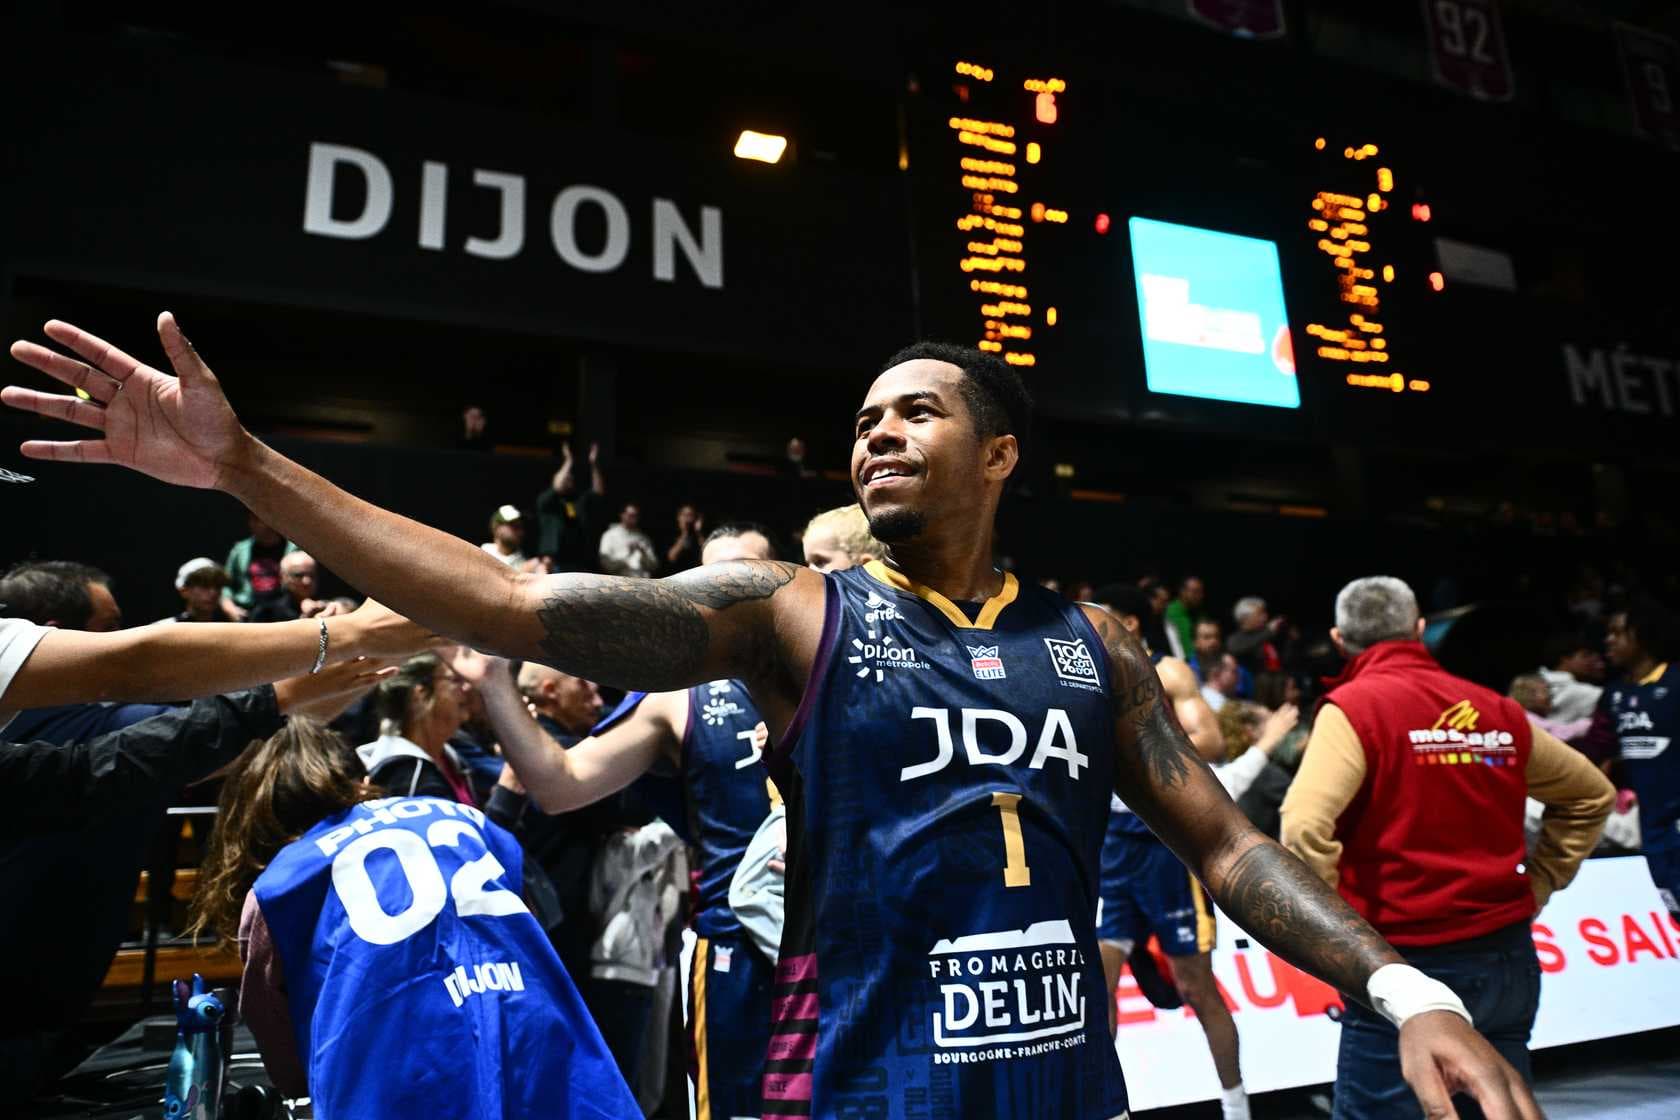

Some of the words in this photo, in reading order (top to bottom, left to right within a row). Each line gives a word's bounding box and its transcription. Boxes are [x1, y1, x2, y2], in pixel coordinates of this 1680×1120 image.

[1435, 0, 1494, 64] 92
[304, 142, 723, 288] DIJON
[1562, 341, 1680, 417] MÉT
[901, 707, 1089, 781] JDA
[991, 792, 1031, 888] 1
[331, 819, 531, 945] 02
[1578, 910, 1680, 967] SAI
[444, 961, 525, 1008] DIJON
[940, 972, 1081, 1031] DELIN
